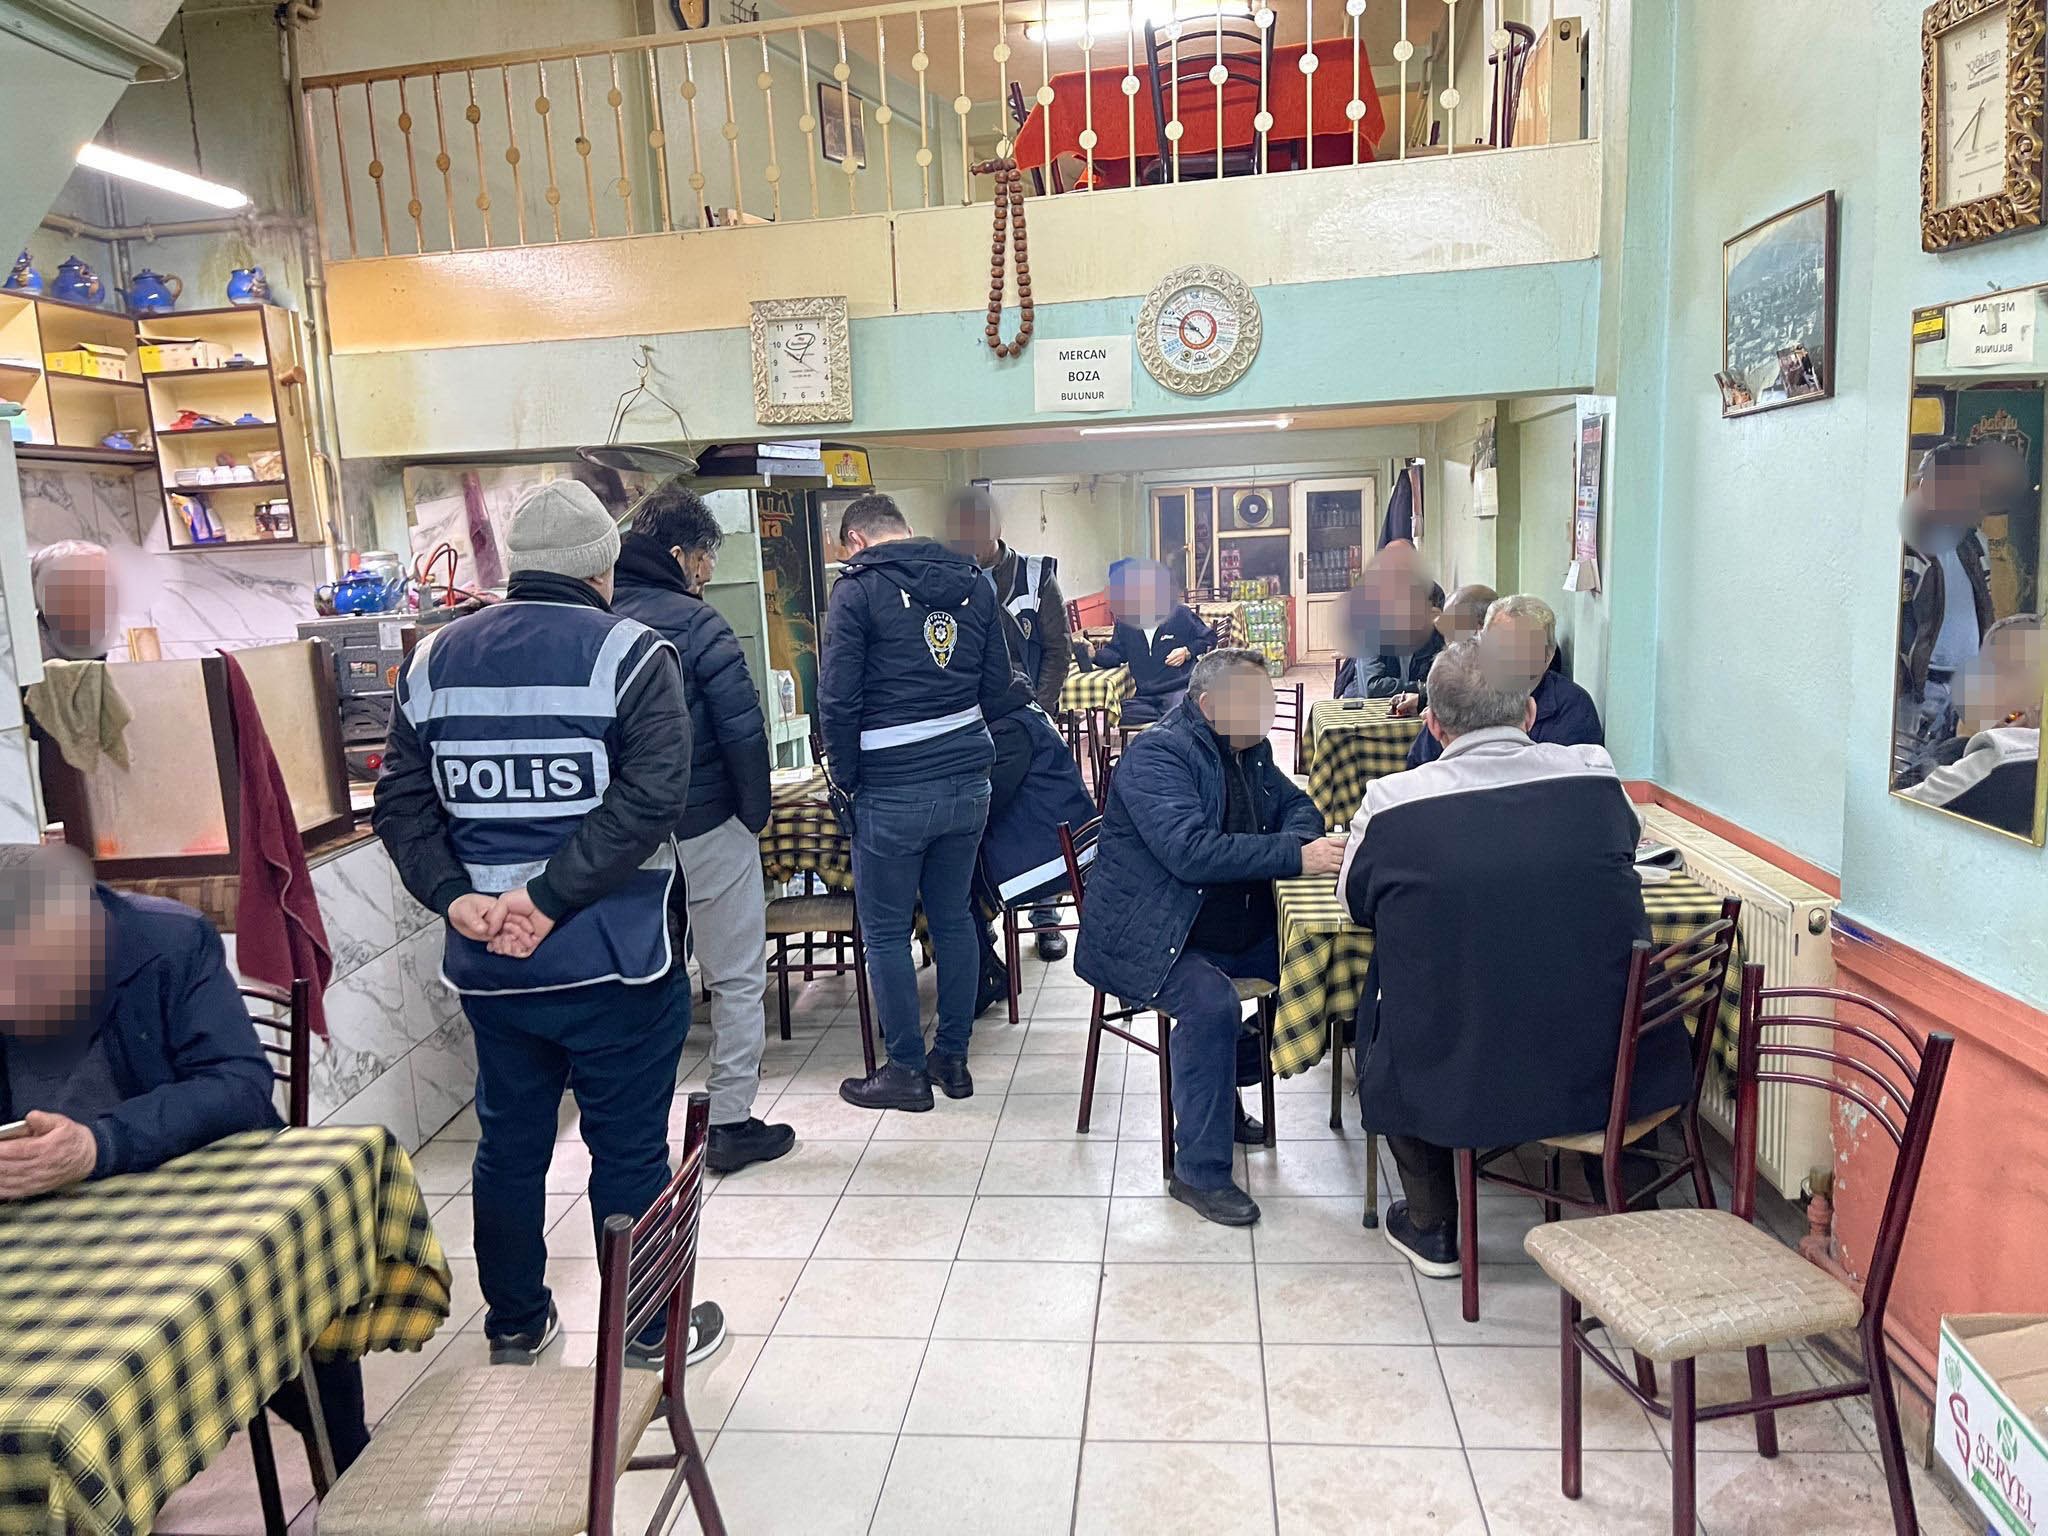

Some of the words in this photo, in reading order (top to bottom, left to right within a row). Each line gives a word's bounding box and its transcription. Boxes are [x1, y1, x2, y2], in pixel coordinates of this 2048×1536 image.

[776, 324, 784, 332] 11
[795, 323, 804, 331] 12
[773, 341, 781, 349] 10
[1059, 349, 1106, 361] MERCAN
[773, 359, 778, 367] 9
[823, 356, 828, 364] 3
[824, 373, 829, 381] 4
[1068, 370, 1101, 382] BOZA
[782, 392, 787, 400] 7
[801, 391, 806, 399] 6
[820, 390, 825, 398] 5
[1061, 391, 1105, 401] BULUNUR
